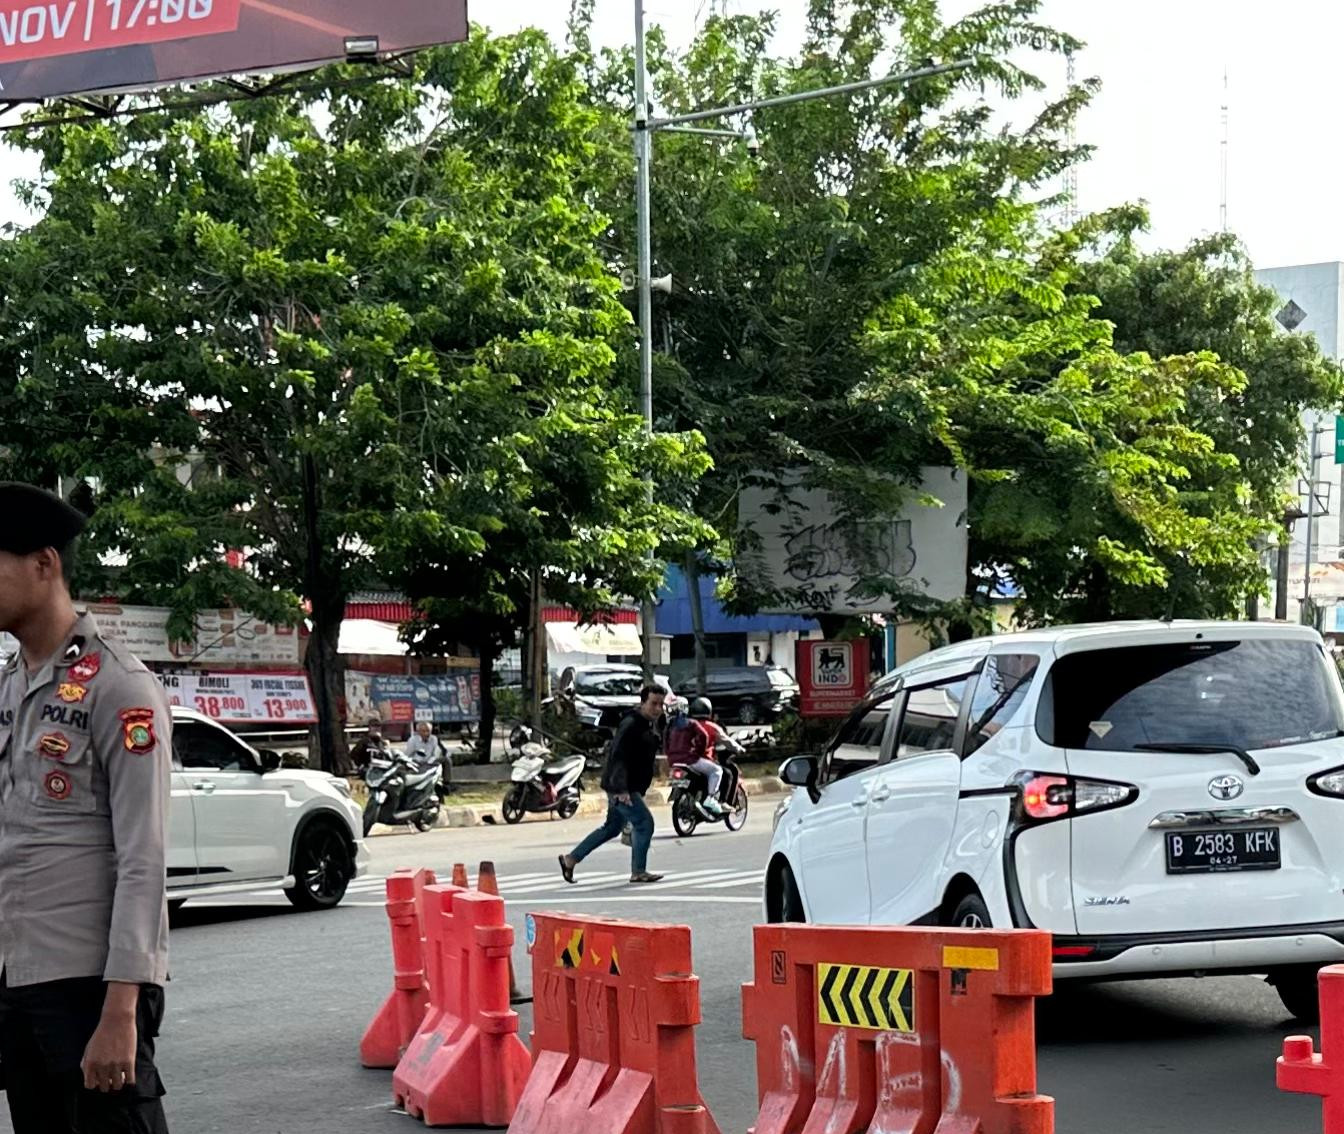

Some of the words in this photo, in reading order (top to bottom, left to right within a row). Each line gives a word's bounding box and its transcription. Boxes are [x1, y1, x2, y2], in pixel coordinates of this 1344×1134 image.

[818, 673, 847, 683] INDO
[41, 704, 89, 731] POLRI
[1173, 835, 1183, 857] B
[1194, 833, 1235, 856] 2583
[1244, 831, 1275, 853] KFK
